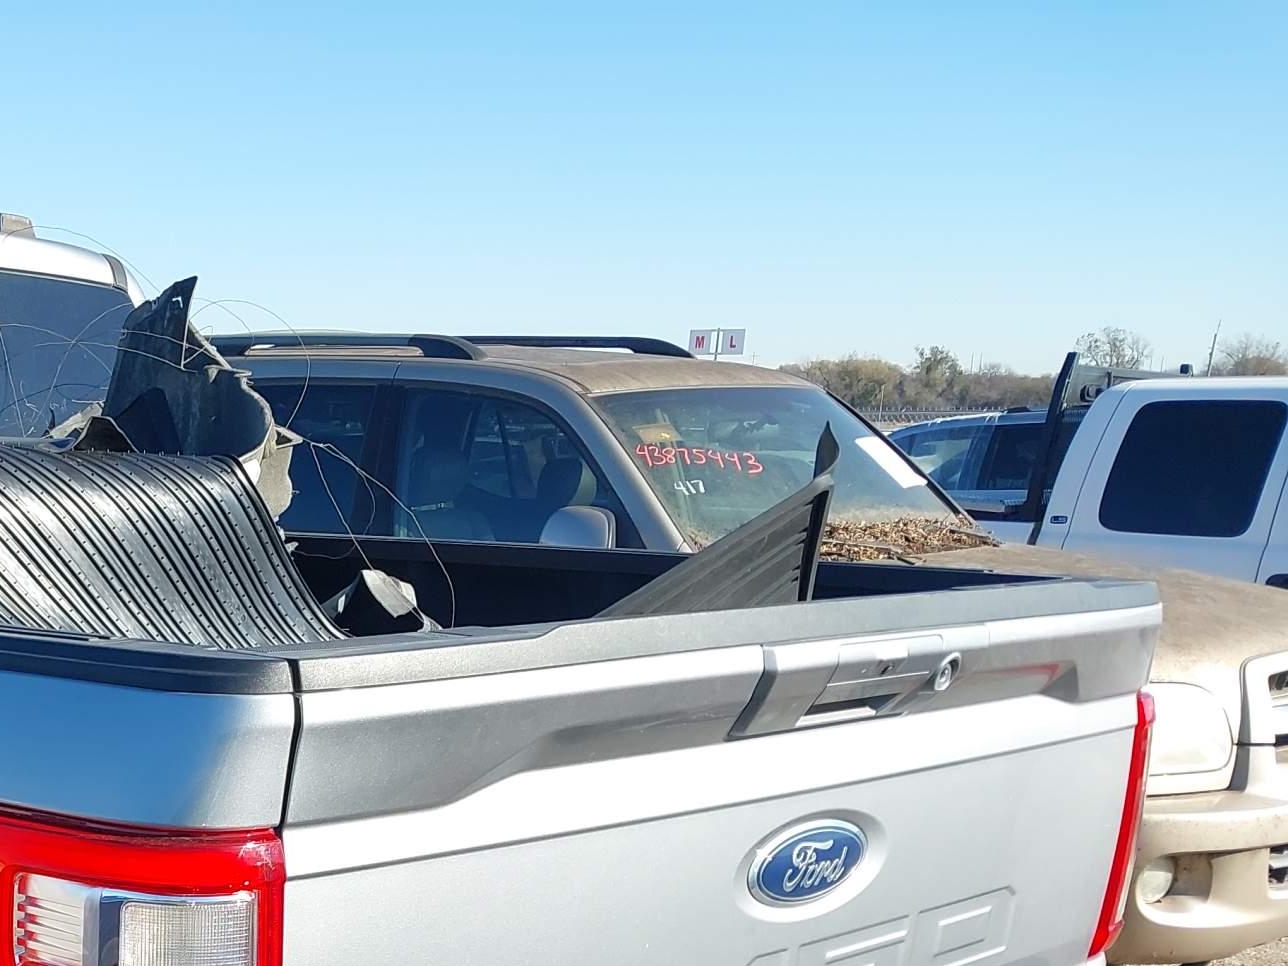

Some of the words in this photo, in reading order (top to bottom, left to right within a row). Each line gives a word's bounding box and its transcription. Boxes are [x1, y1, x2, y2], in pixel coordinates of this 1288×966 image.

[695, 335, 705, 349] M
[729, 335, 737, 349] L
[635, 443, 765, 475] 43875443
[674, 479, 706, 496] 417
[783, 839, 848, 893] Ford
